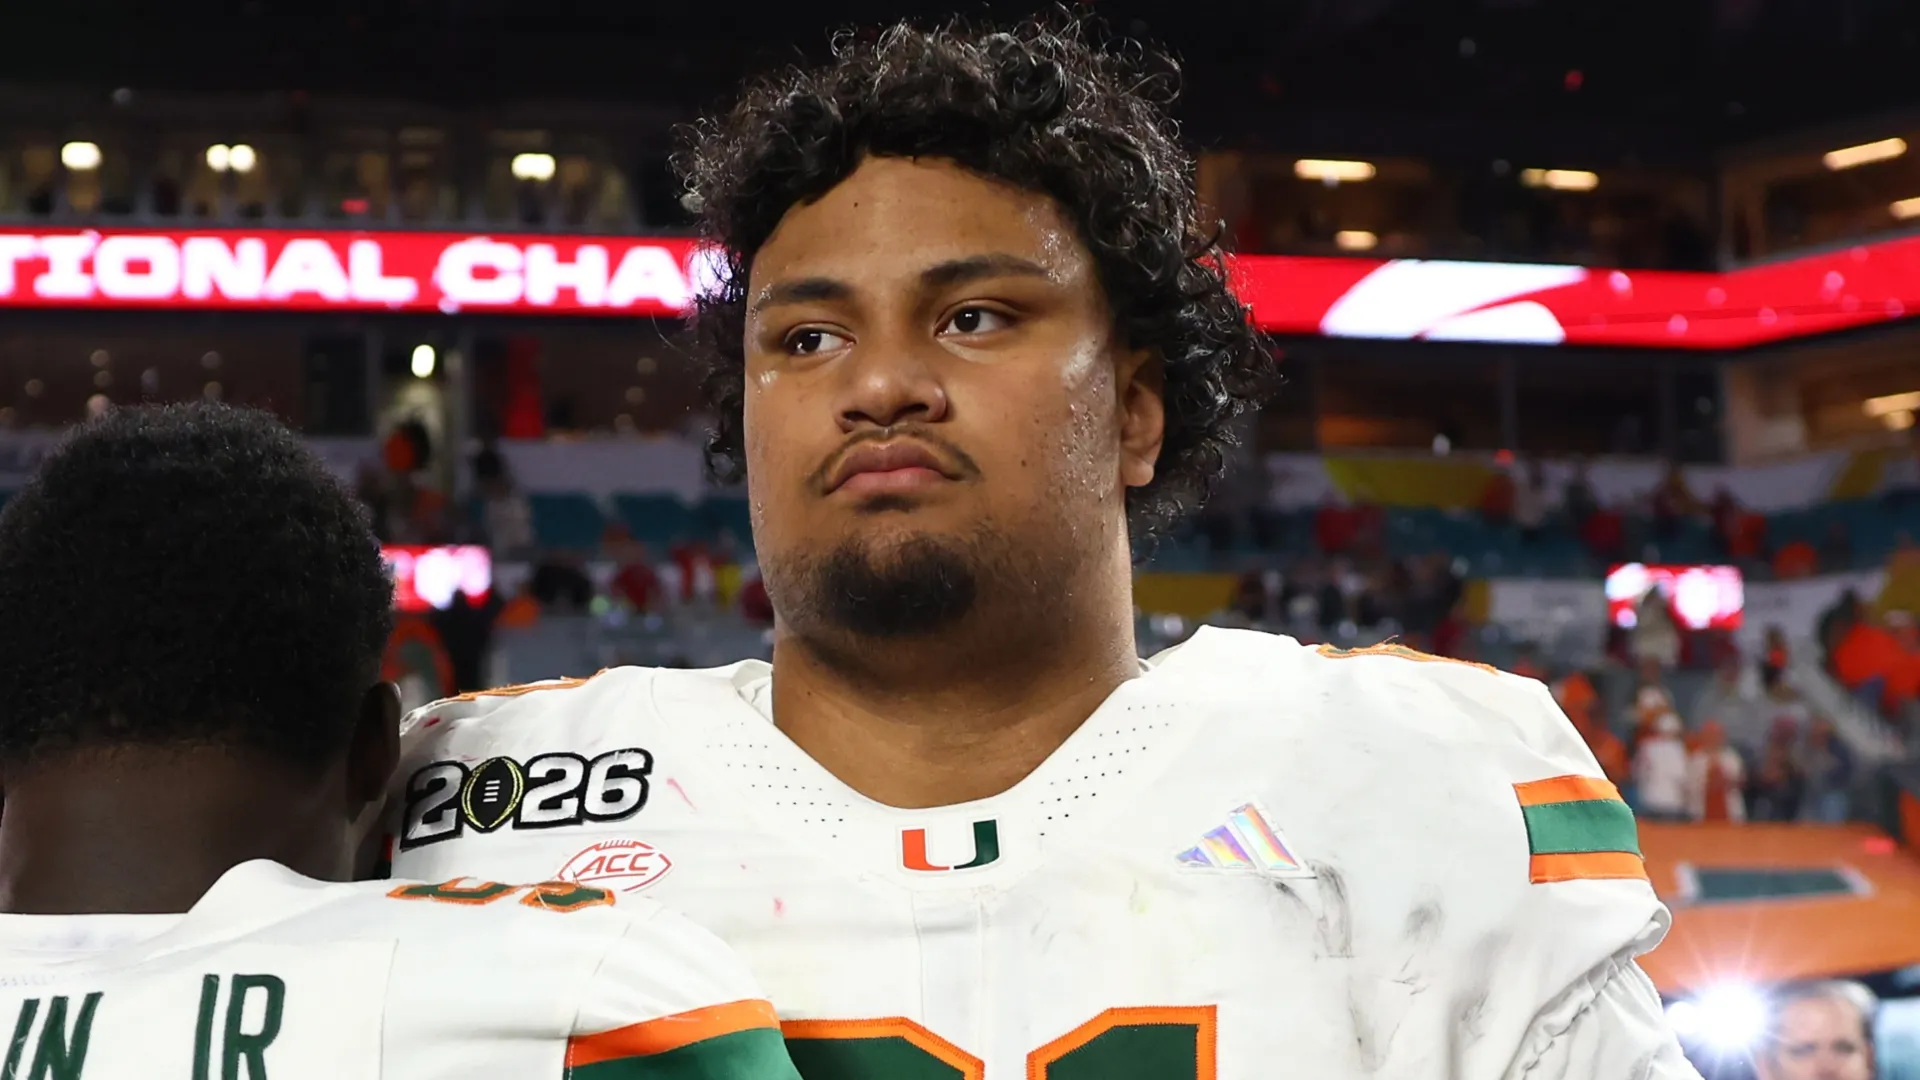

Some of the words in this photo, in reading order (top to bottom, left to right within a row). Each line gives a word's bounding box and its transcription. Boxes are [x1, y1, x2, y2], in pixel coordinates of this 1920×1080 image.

[400, 748, 654, 852] 2026
[575, 852, 654, 878] ACC
[902, 819, 999, 871] U
